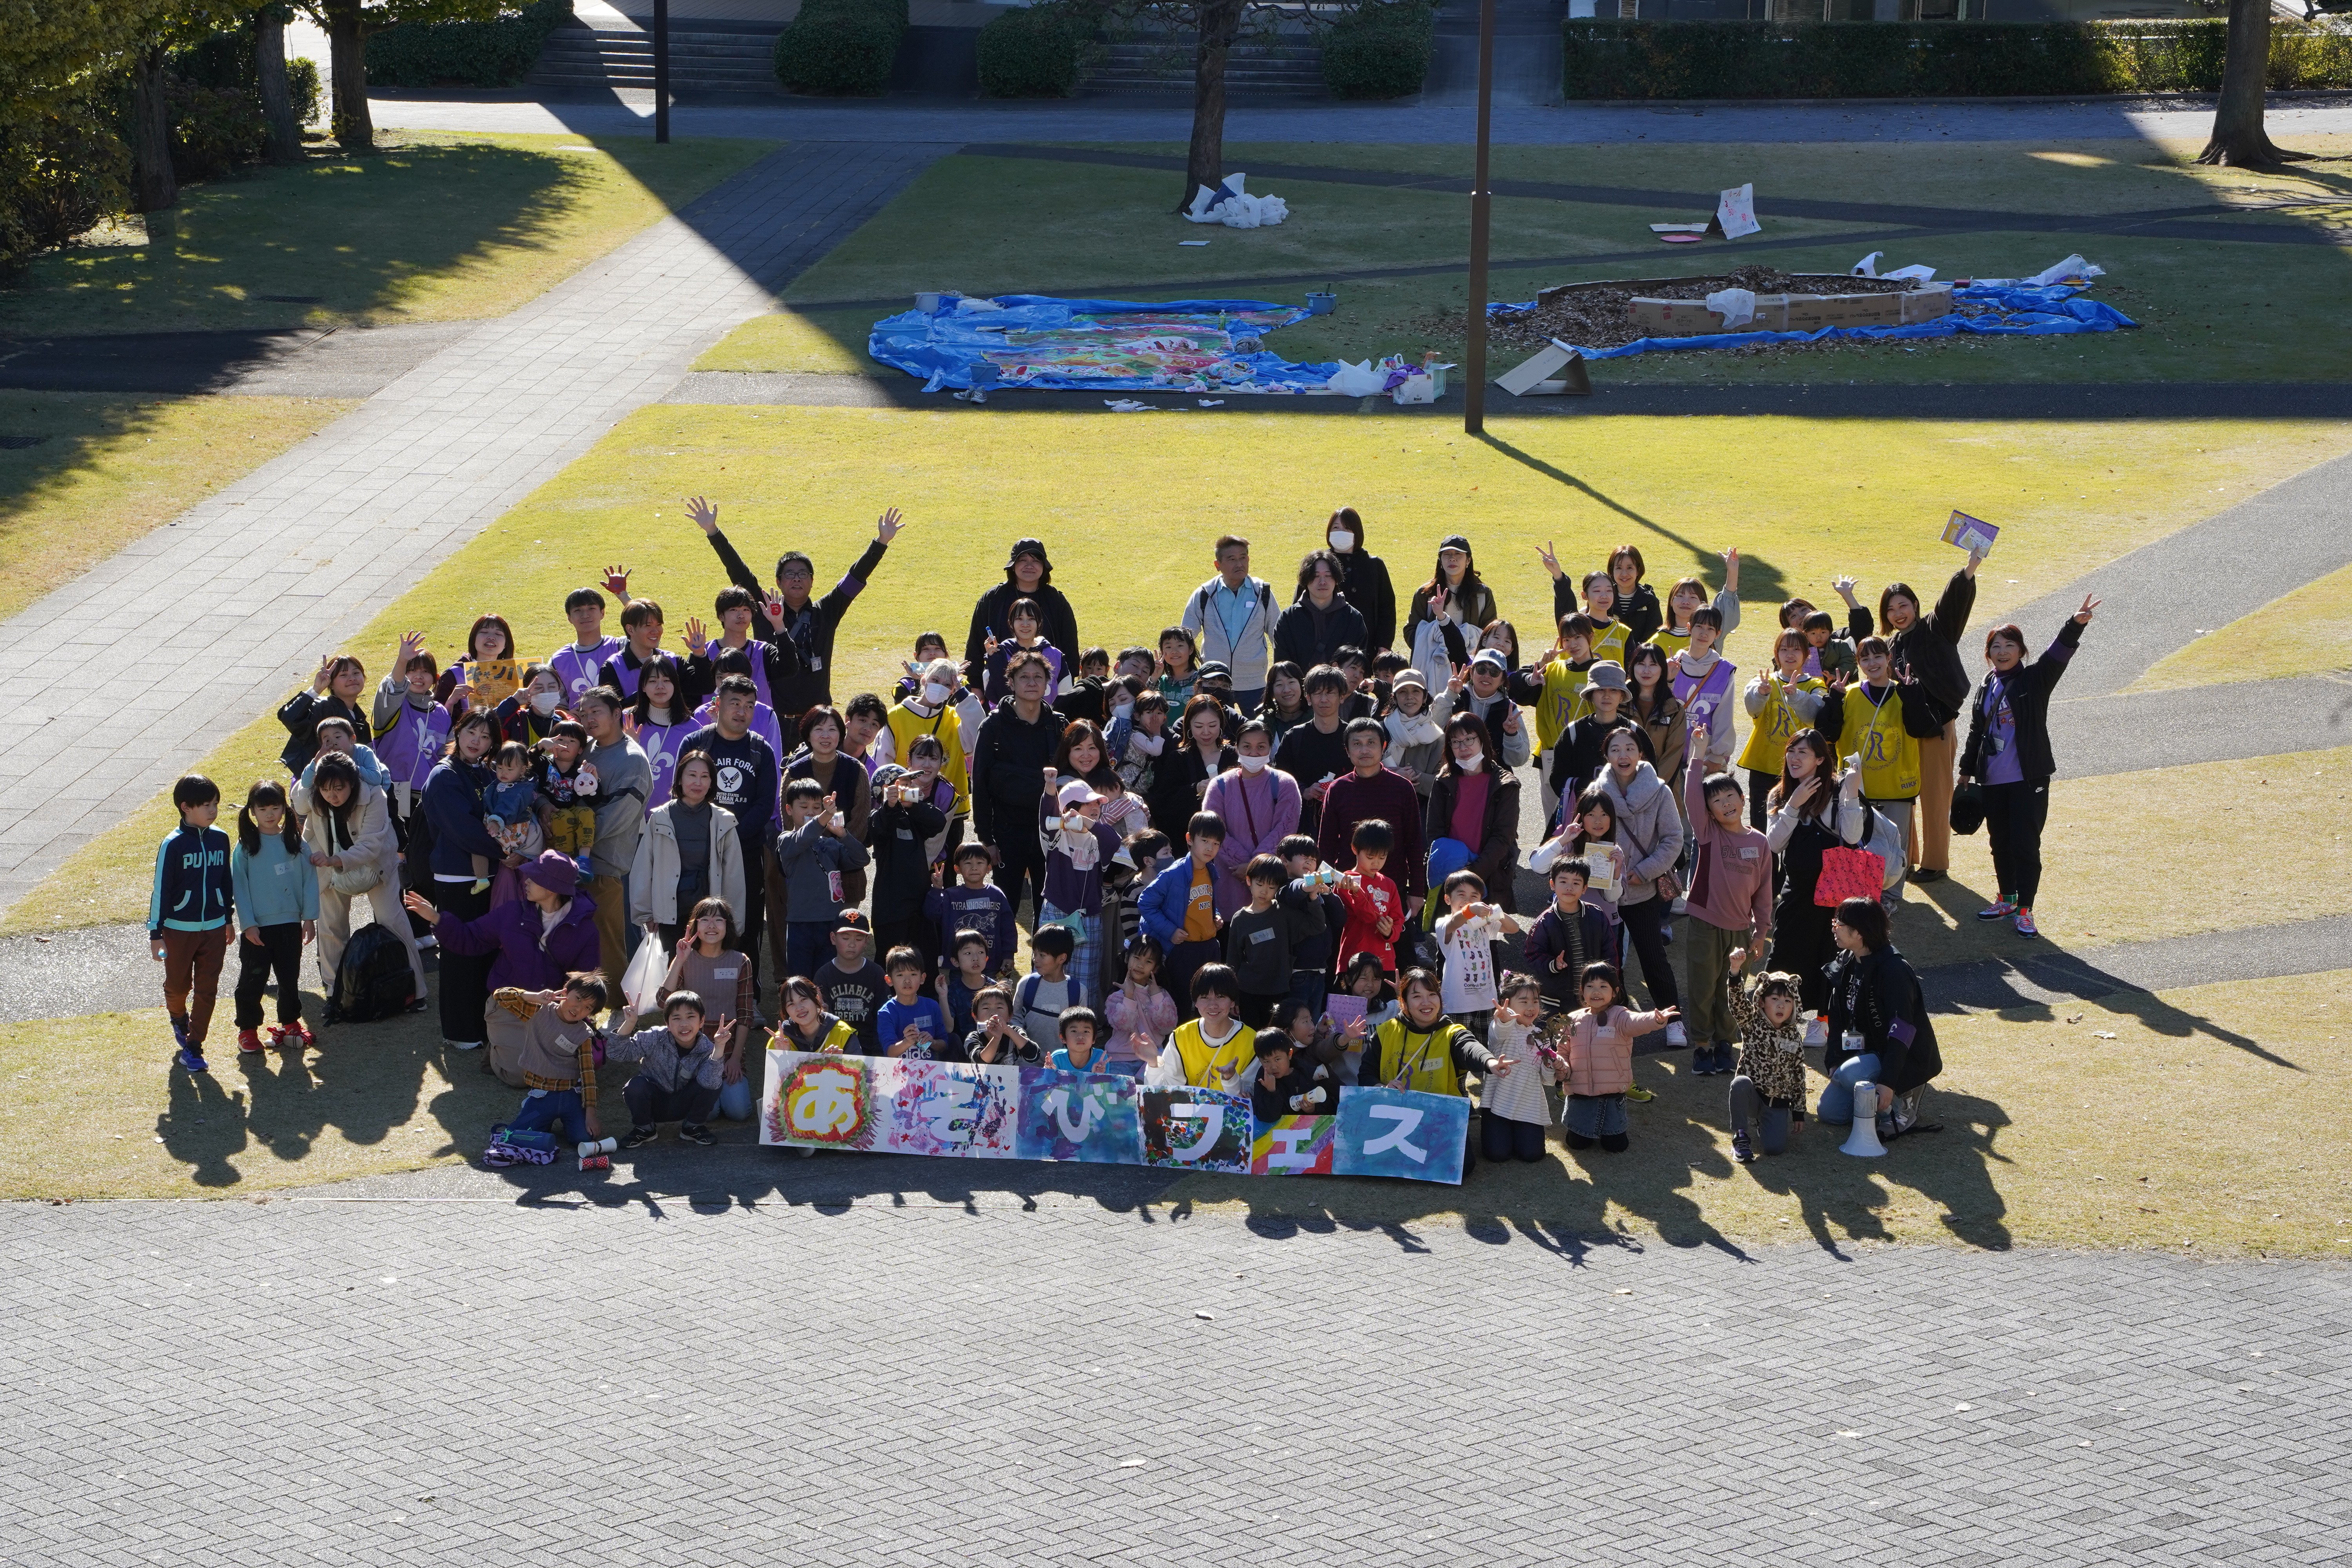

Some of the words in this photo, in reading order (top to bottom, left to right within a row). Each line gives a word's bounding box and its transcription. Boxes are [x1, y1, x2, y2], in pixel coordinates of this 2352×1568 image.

[182, 850, 224, 869] PUMA
[1199, 901, 1210, 910] NYC
[898, 1047, 932, 1059] didas
